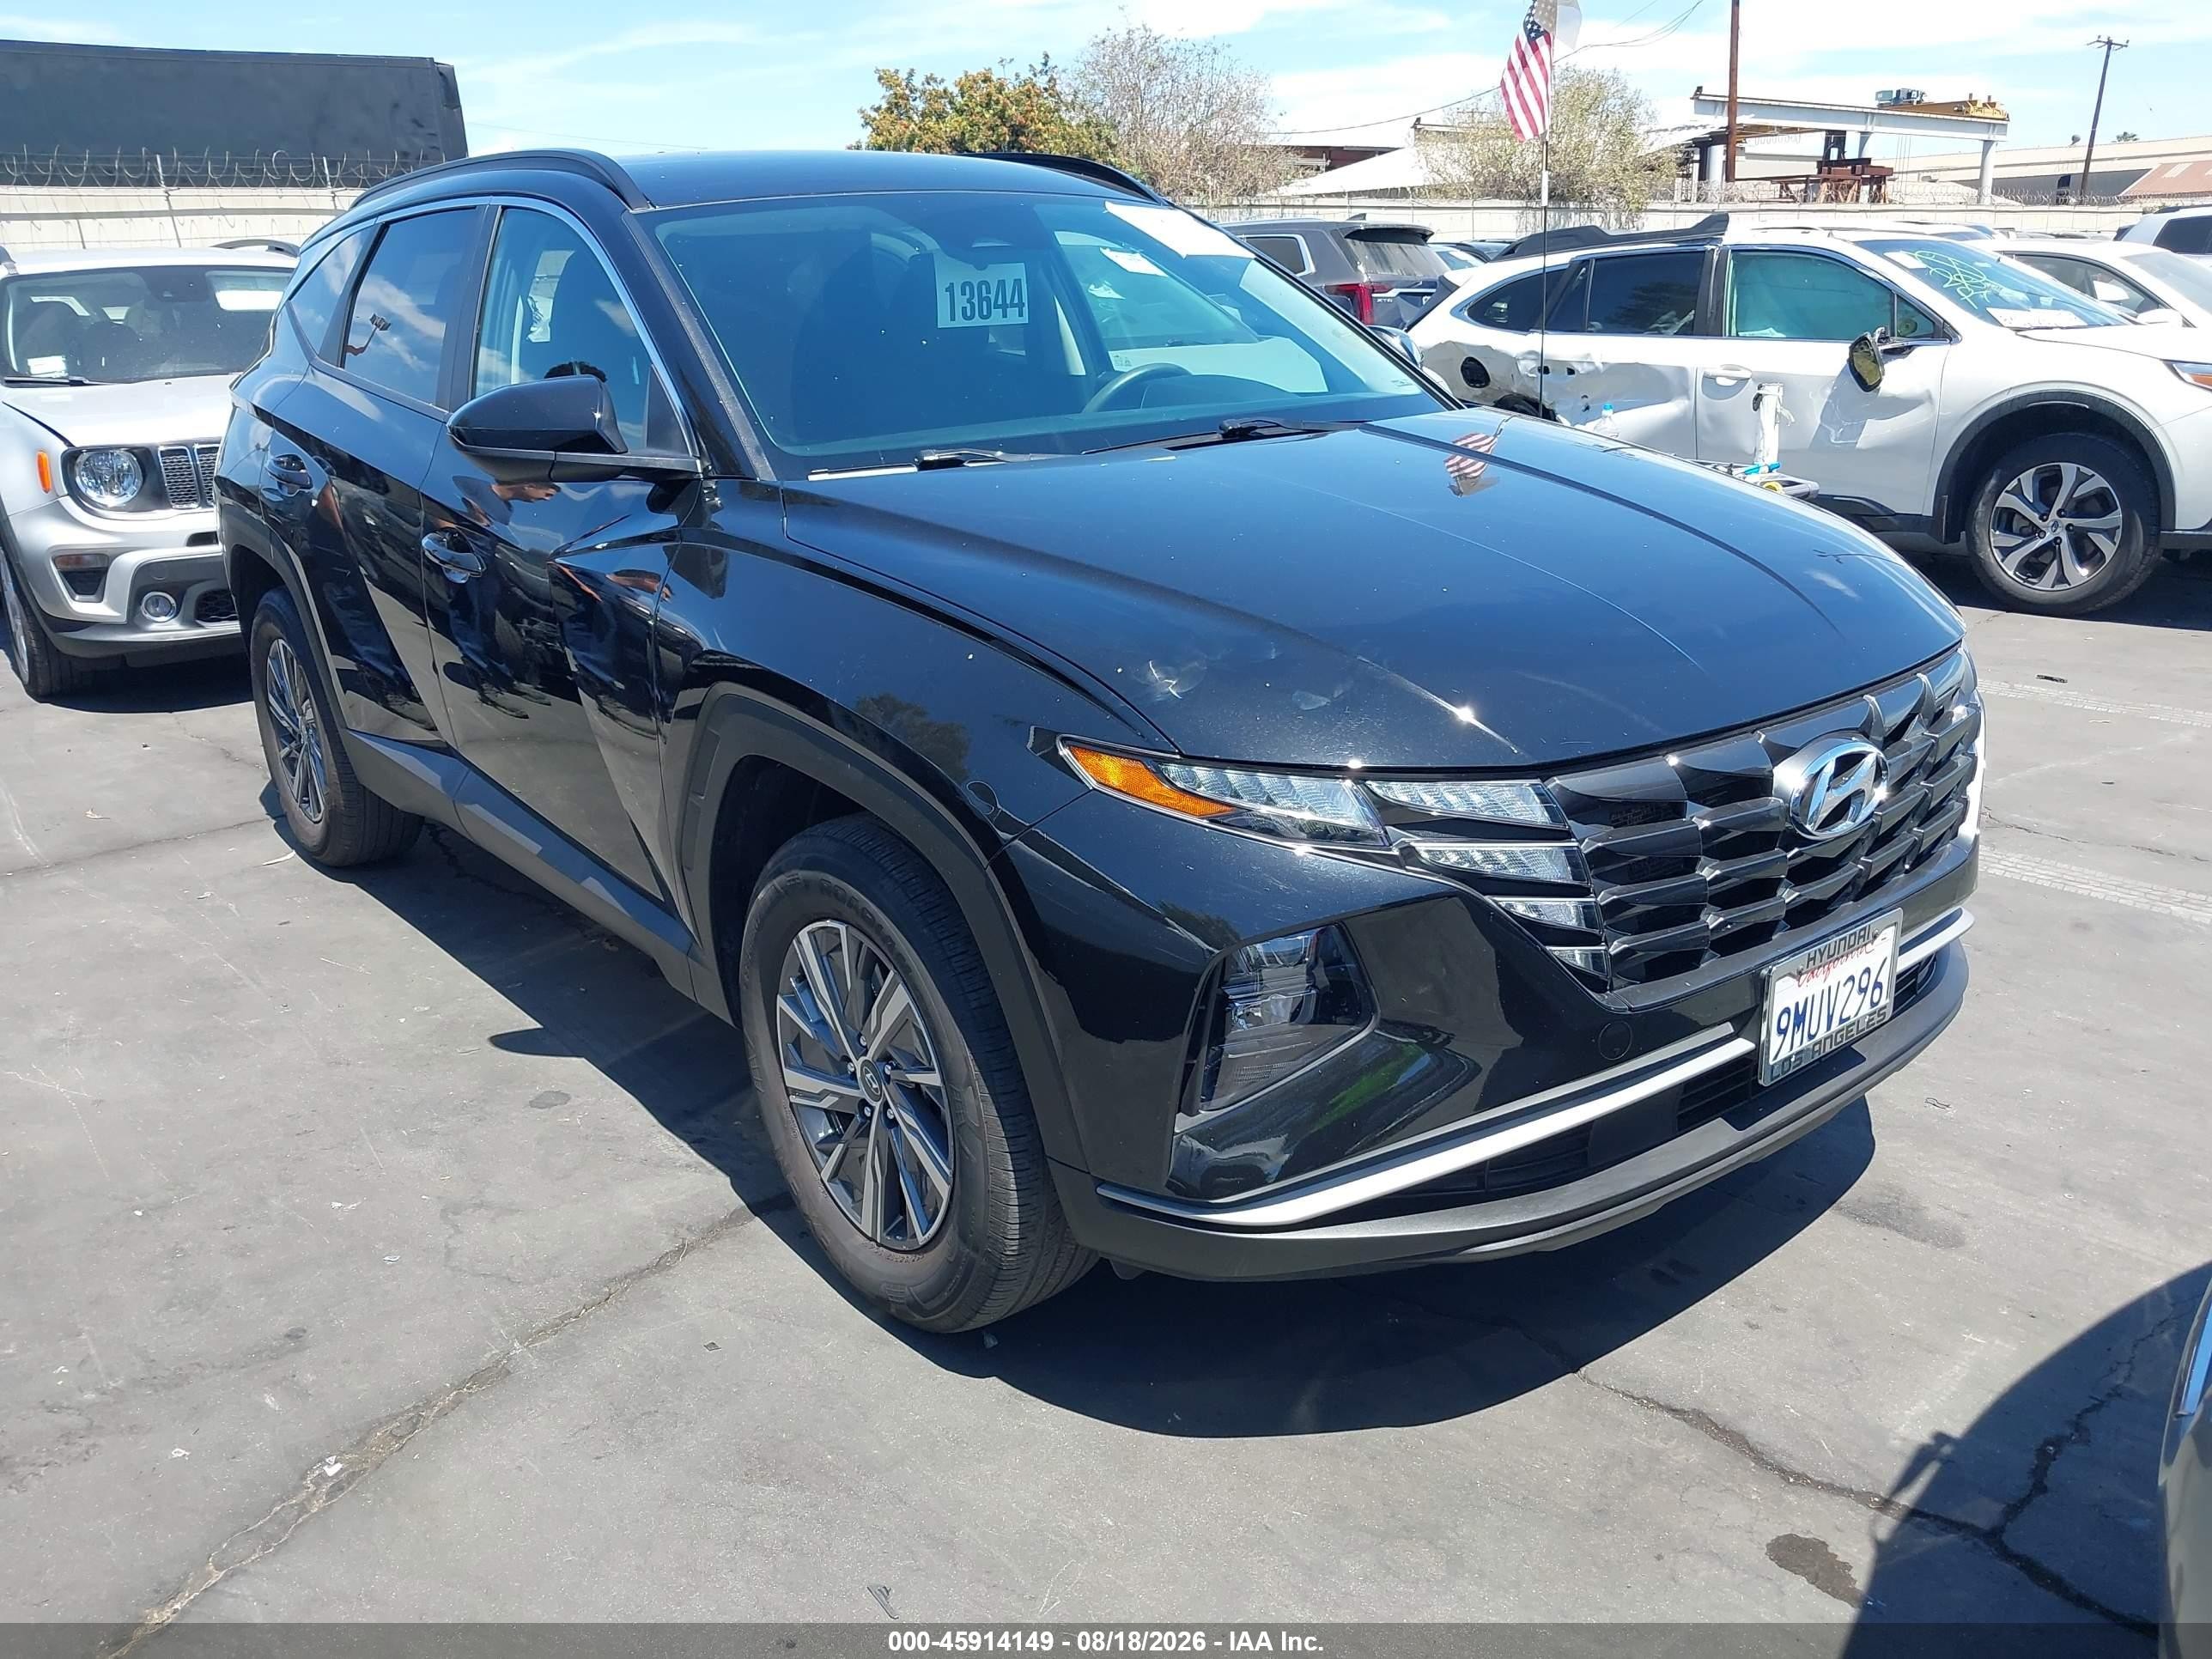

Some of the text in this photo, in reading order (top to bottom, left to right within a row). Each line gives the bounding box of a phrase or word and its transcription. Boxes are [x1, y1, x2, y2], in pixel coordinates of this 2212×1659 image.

[945, 278, 1025, 322] 13644
[1806, 925, 1871, 969] HYUNDAI
[1772, 956, 1888, 1061] 9MUV296
[1771, 1006, 1888, 1079] LOS ANGELES
